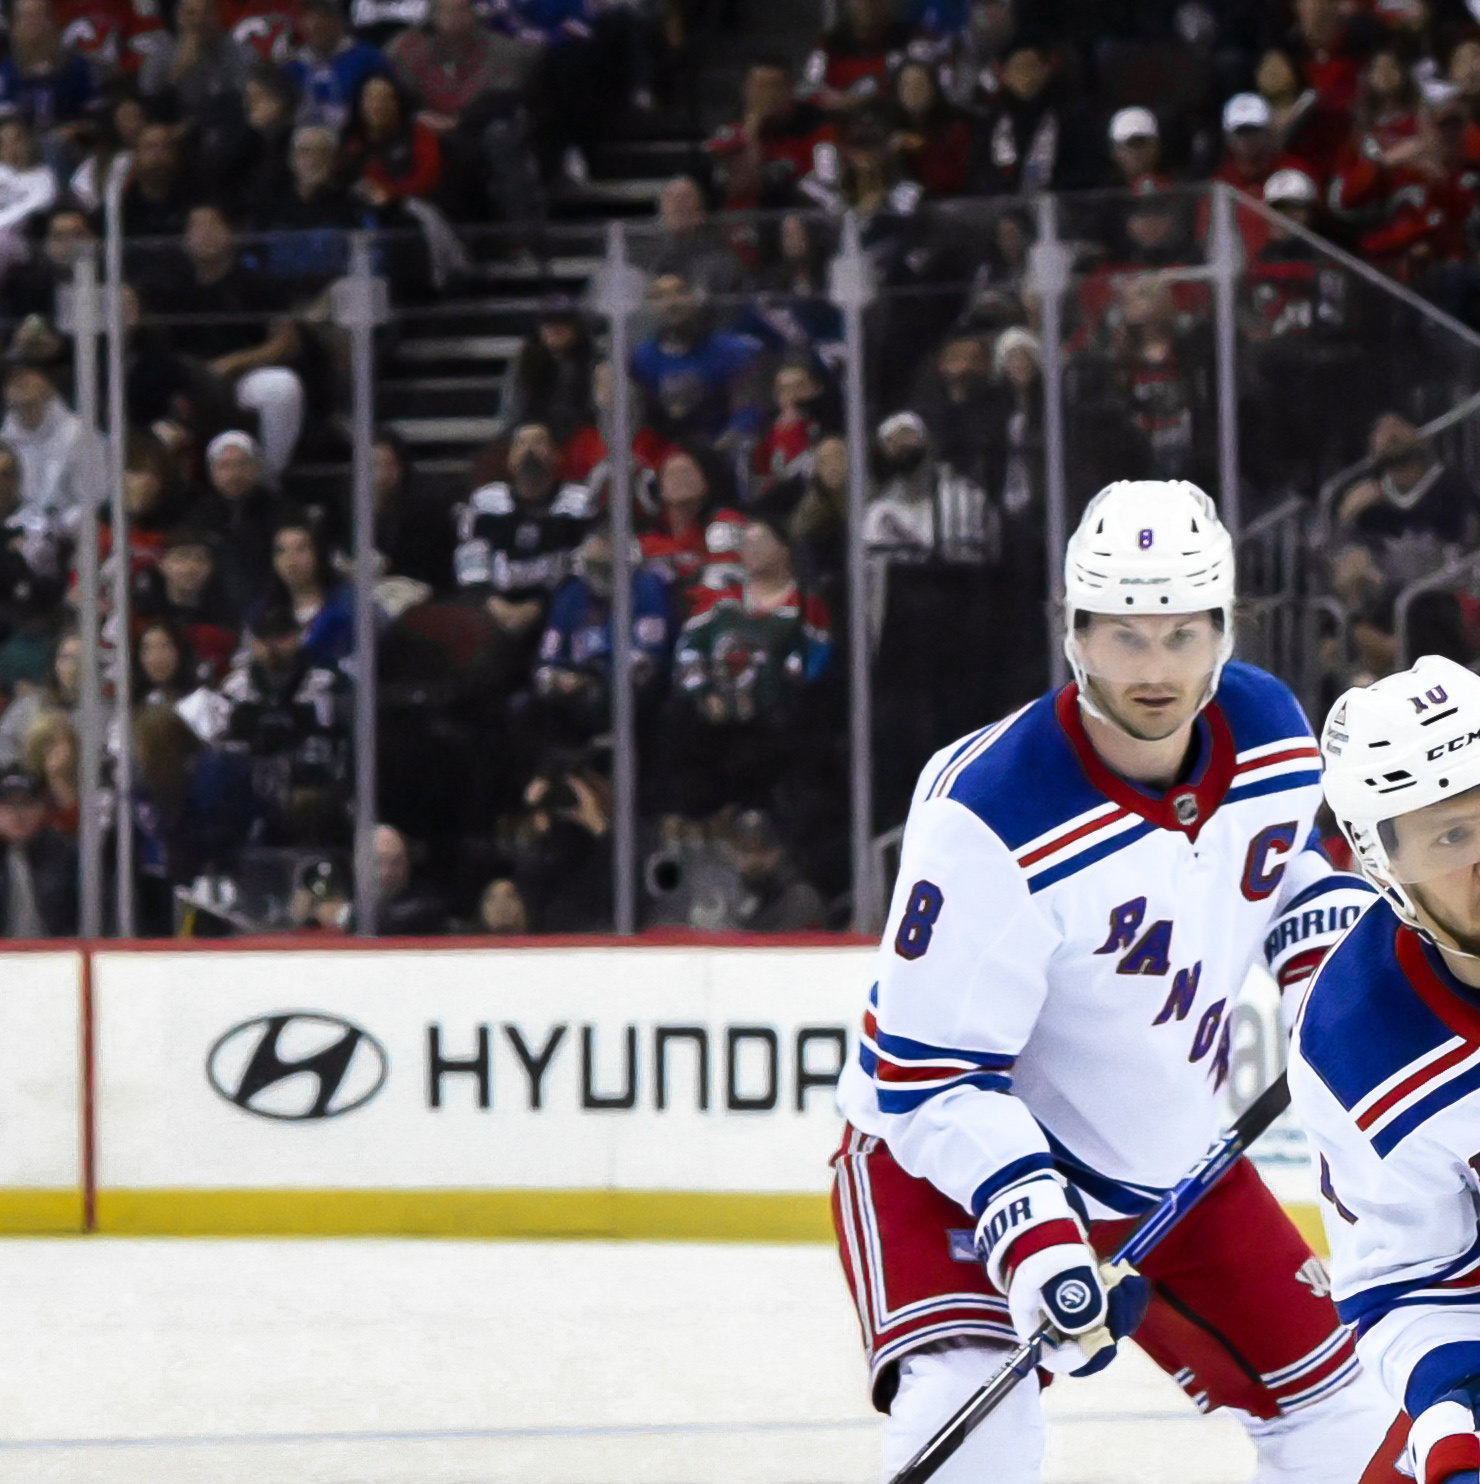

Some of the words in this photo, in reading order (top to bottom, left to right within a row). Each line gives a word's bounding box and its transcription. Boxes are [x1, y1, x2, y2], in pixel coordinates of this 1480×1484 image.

[1138, 528, 1153, 550] 8
[1240, 821, 1299, 902] C
[894, 879, 944, 961] 8
[427, 1022, 849, 1113] HYUNDA
